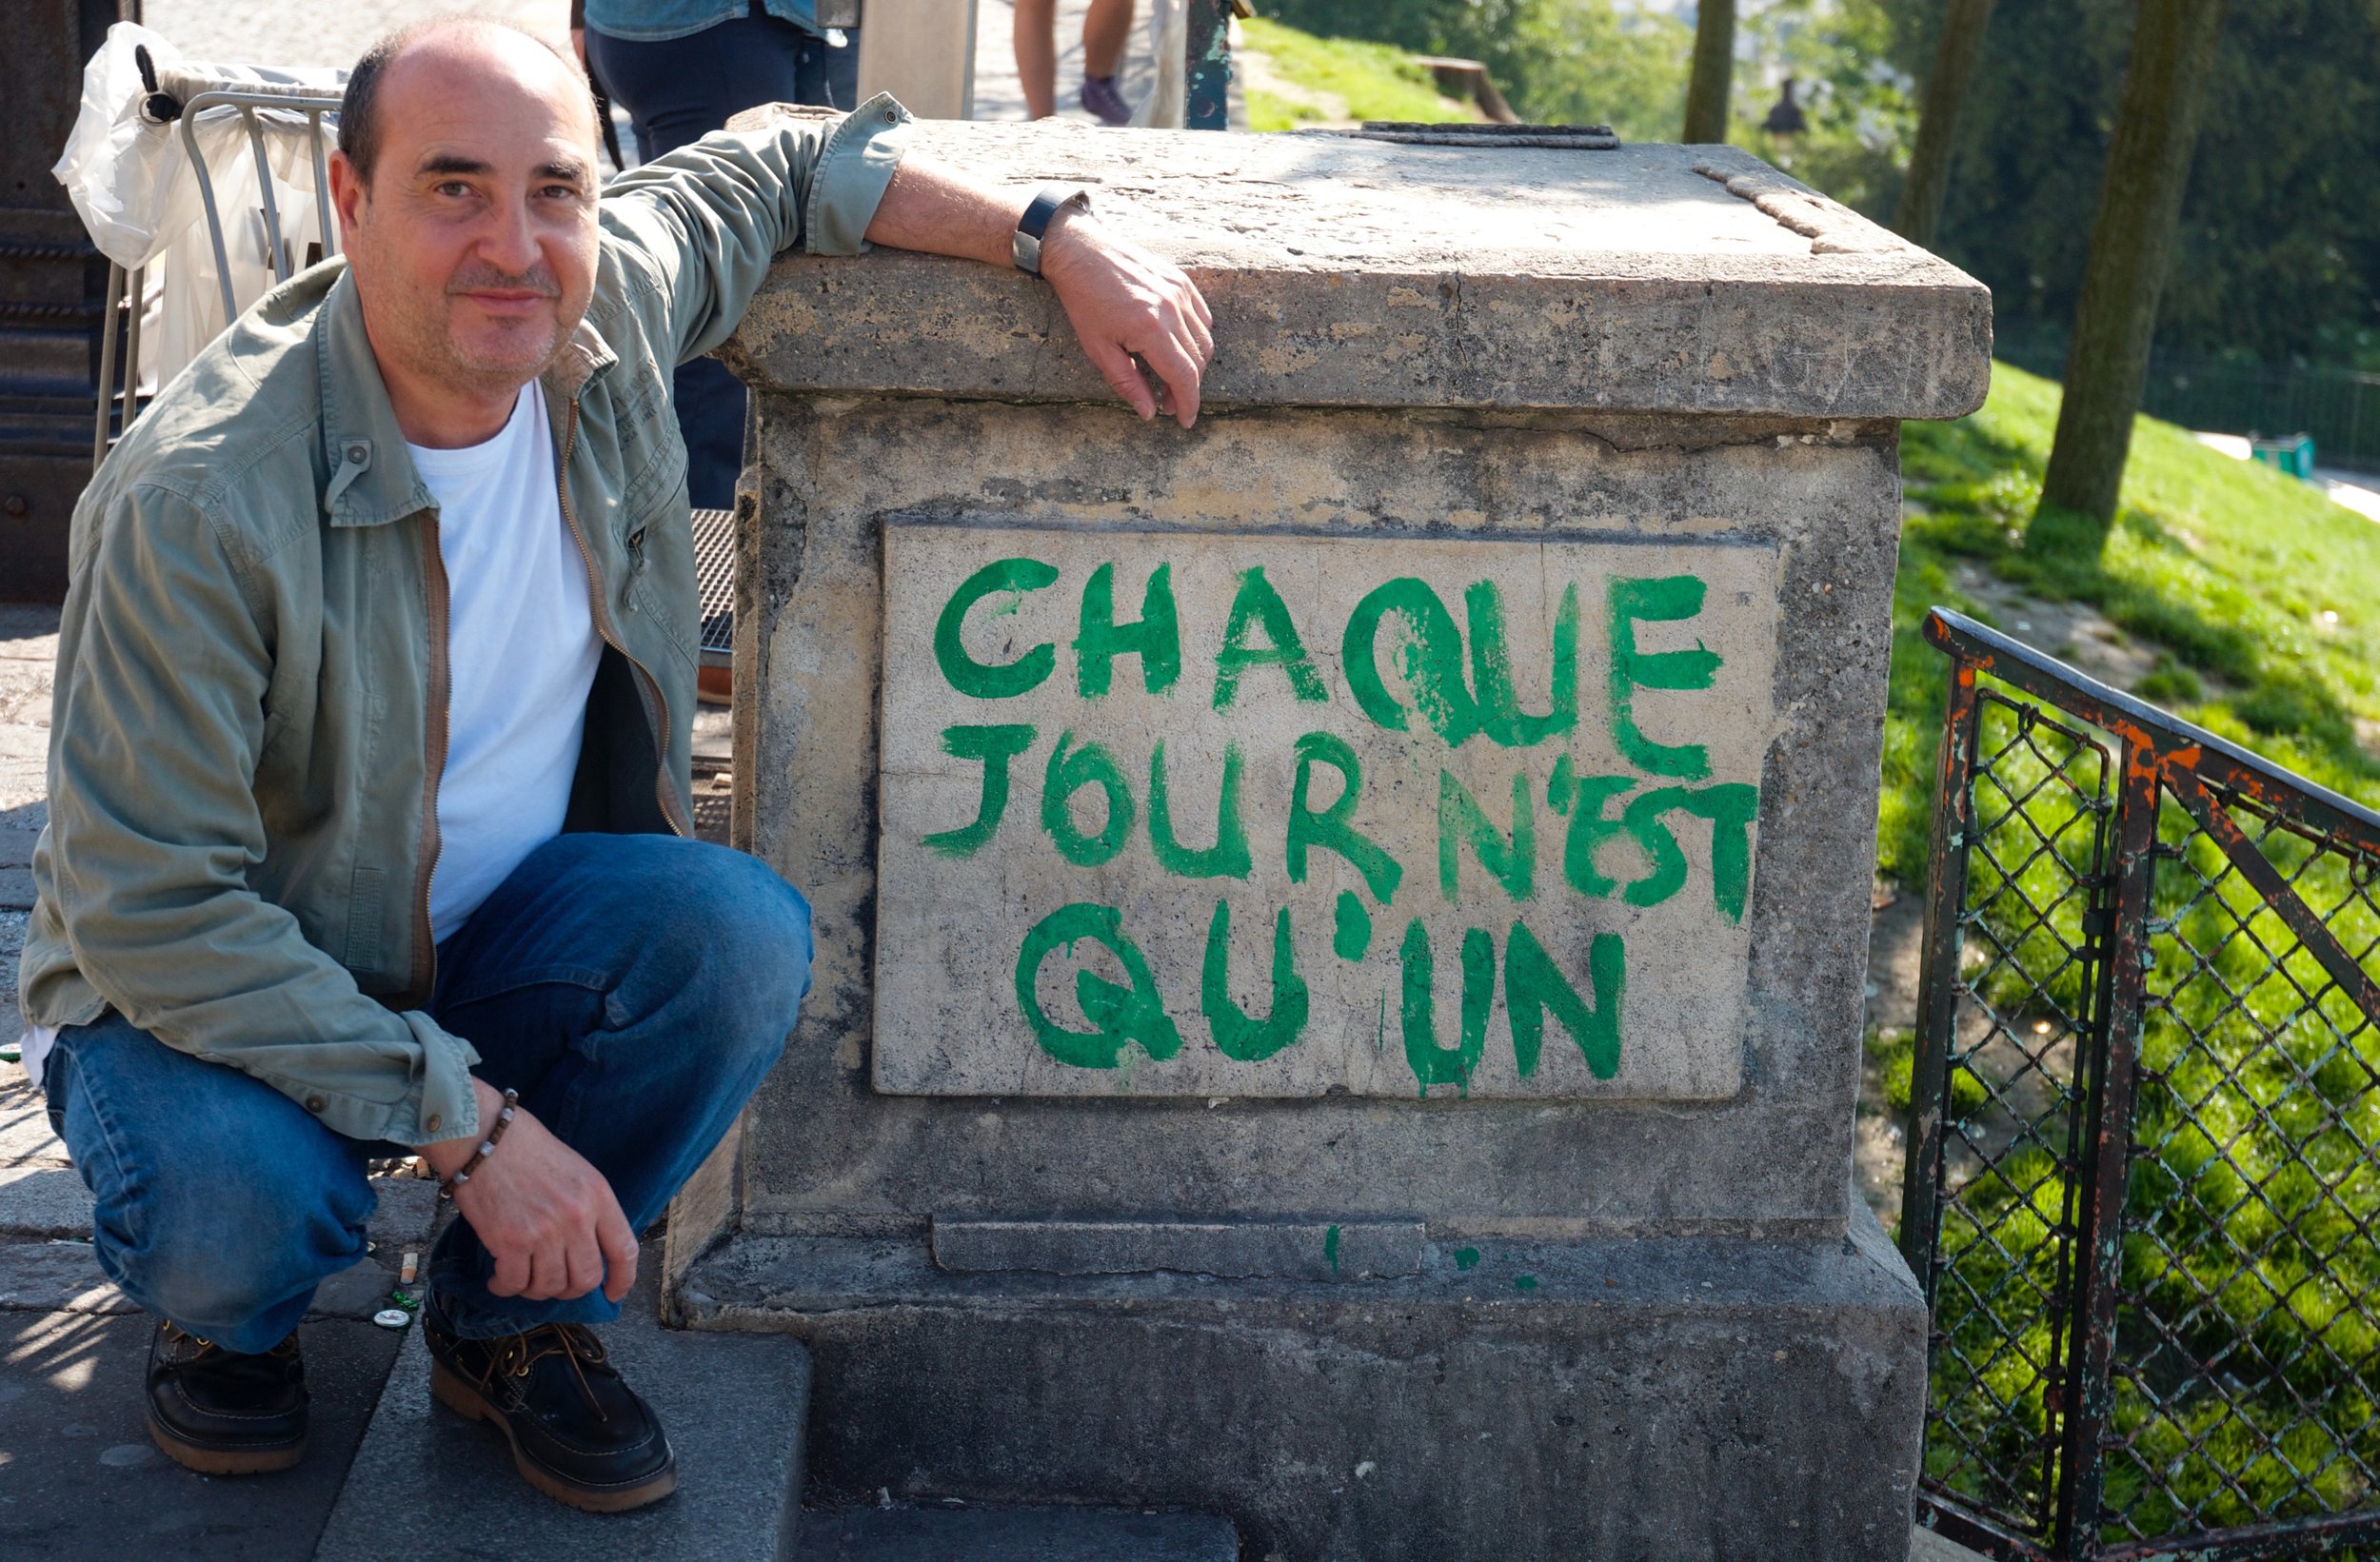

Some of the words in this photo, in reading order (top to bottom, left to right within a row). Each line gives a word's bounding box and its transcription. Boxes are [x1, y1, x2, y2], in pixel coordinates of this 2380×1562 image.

[934, 557, 1723, 780] CHAQUE
[922, 724, 1403, 905] JOUR
[1438, 754, 1760, 923] N'EST
[1015, 890, 1626, 1097] QU'UN
